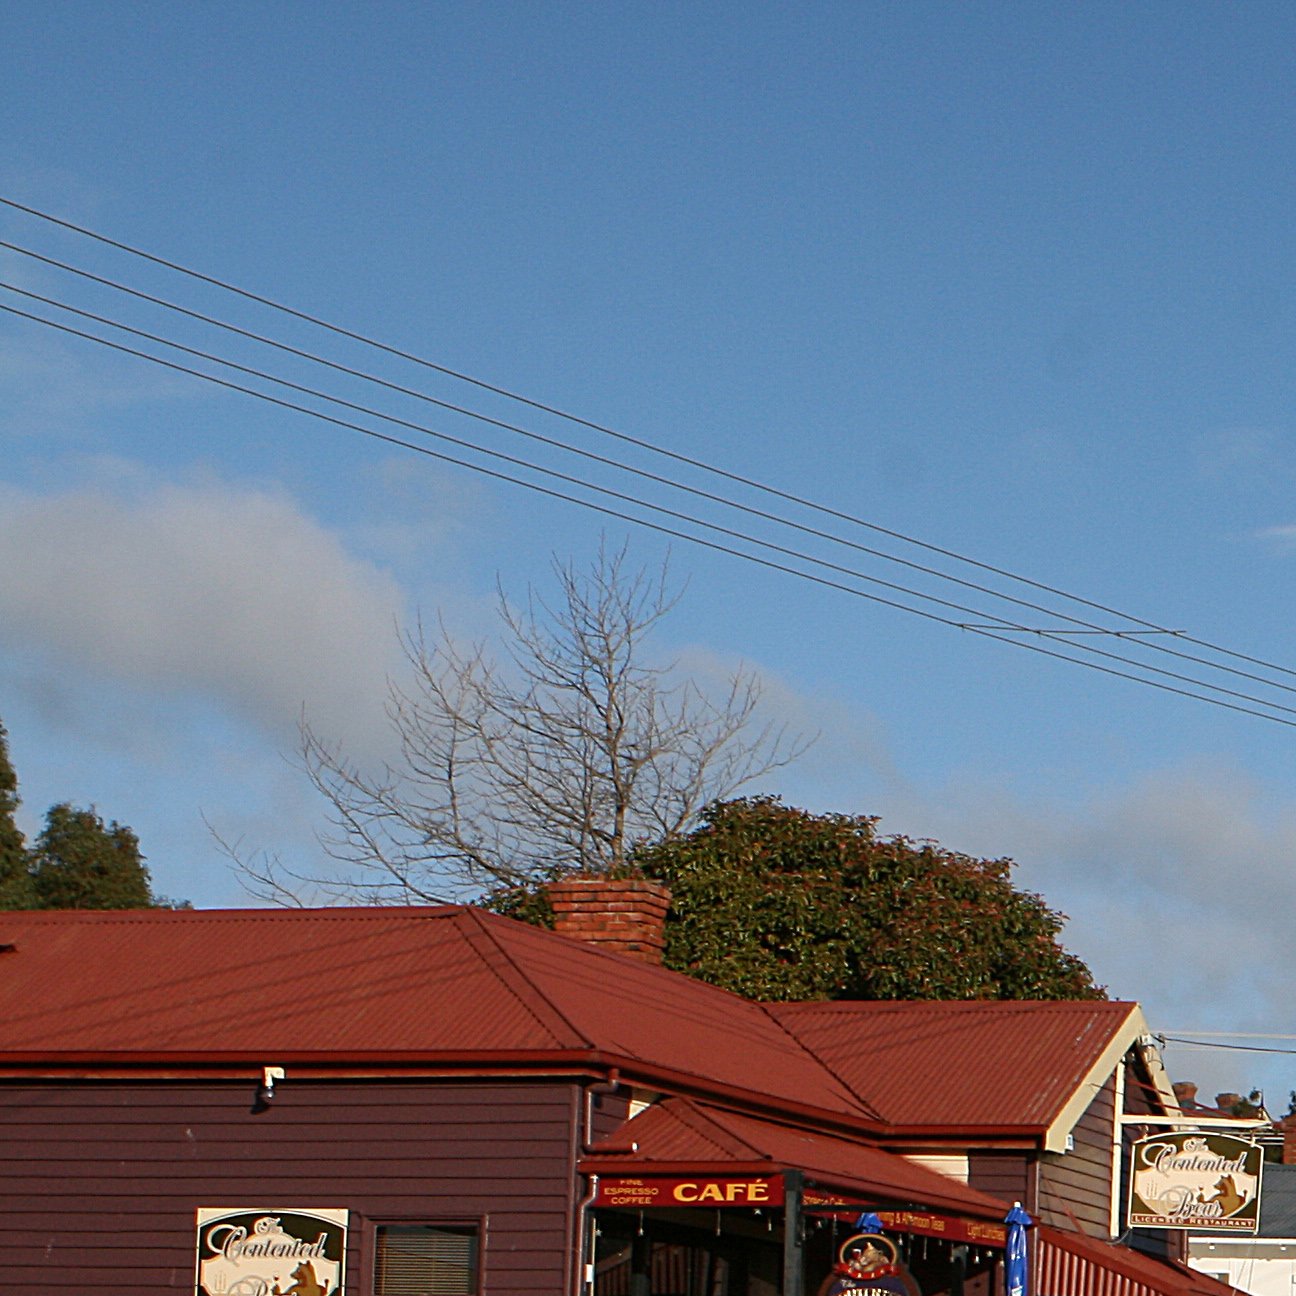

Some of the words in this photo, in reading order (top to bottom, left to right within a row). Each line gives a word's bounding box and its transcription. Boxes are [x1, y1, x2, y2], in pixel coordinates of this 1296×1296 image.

[1141, 1143, 1247, 1178] Contented
[673, 1178, 769, 1202] CAFÉ
[1189, 1217, 1252, 1226] RESTAURANT
[207, 1224, 328, 1266] Contented
